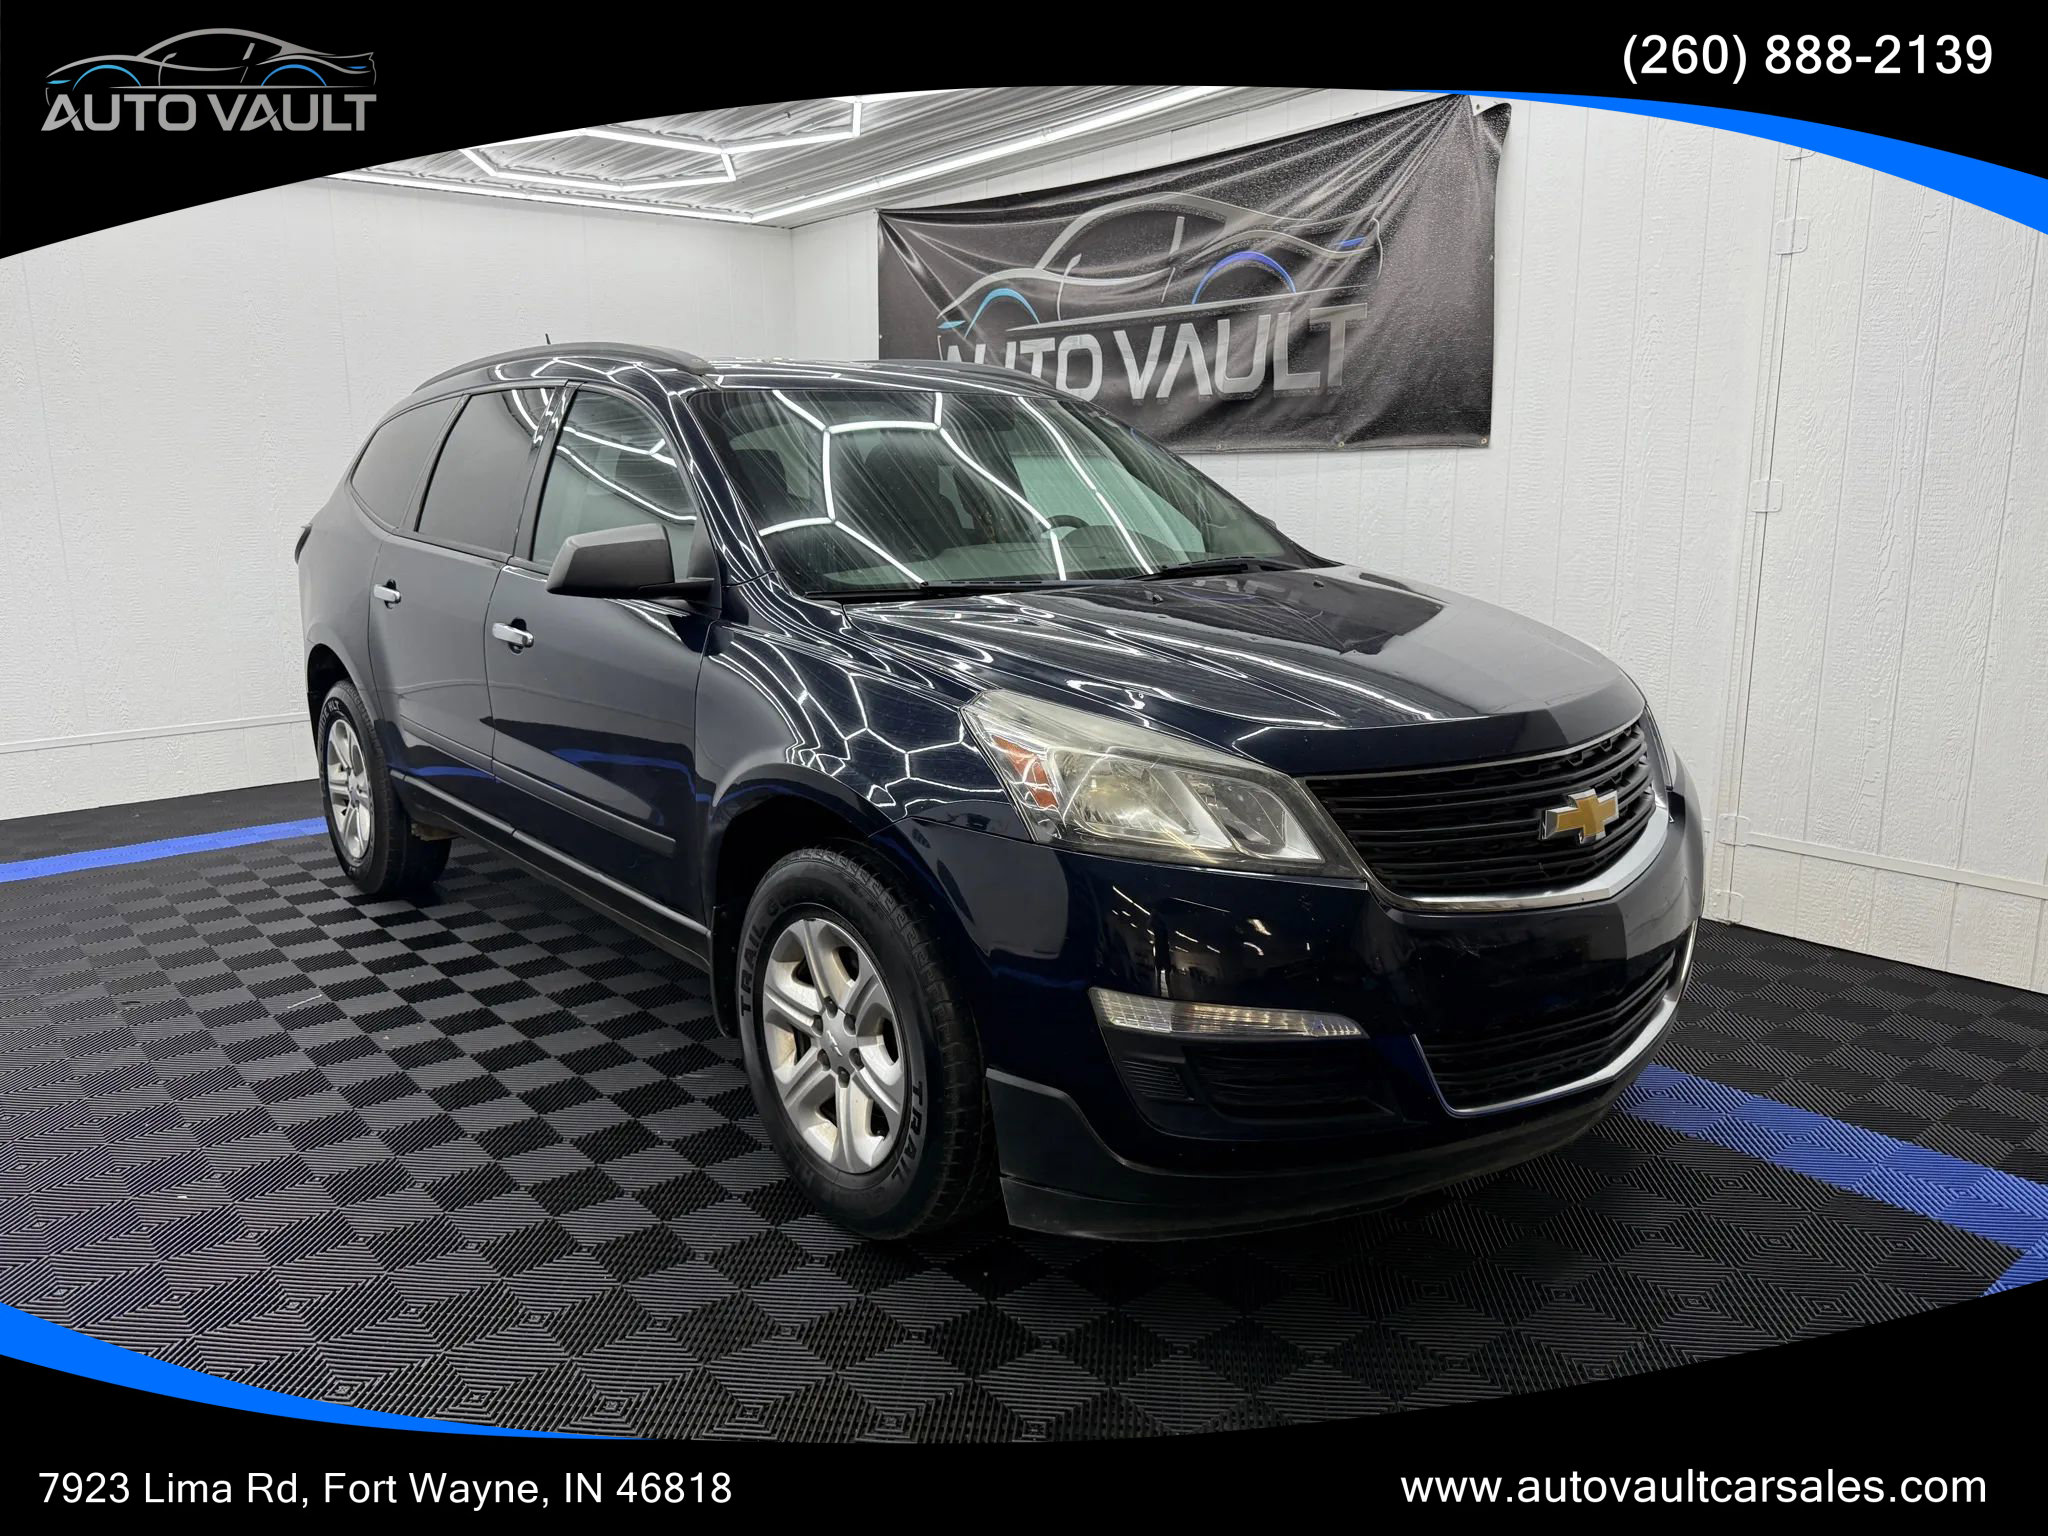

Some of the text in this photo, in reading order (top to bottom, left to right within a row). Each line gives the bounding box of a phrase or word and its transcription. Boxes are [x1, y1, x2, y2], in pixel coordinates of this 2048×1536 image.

[1114, 302, 1368, 400] VAULT
[741, 924, 767, 1017] TRAIL
[891, 1080, 923, 1183] TRAIL
